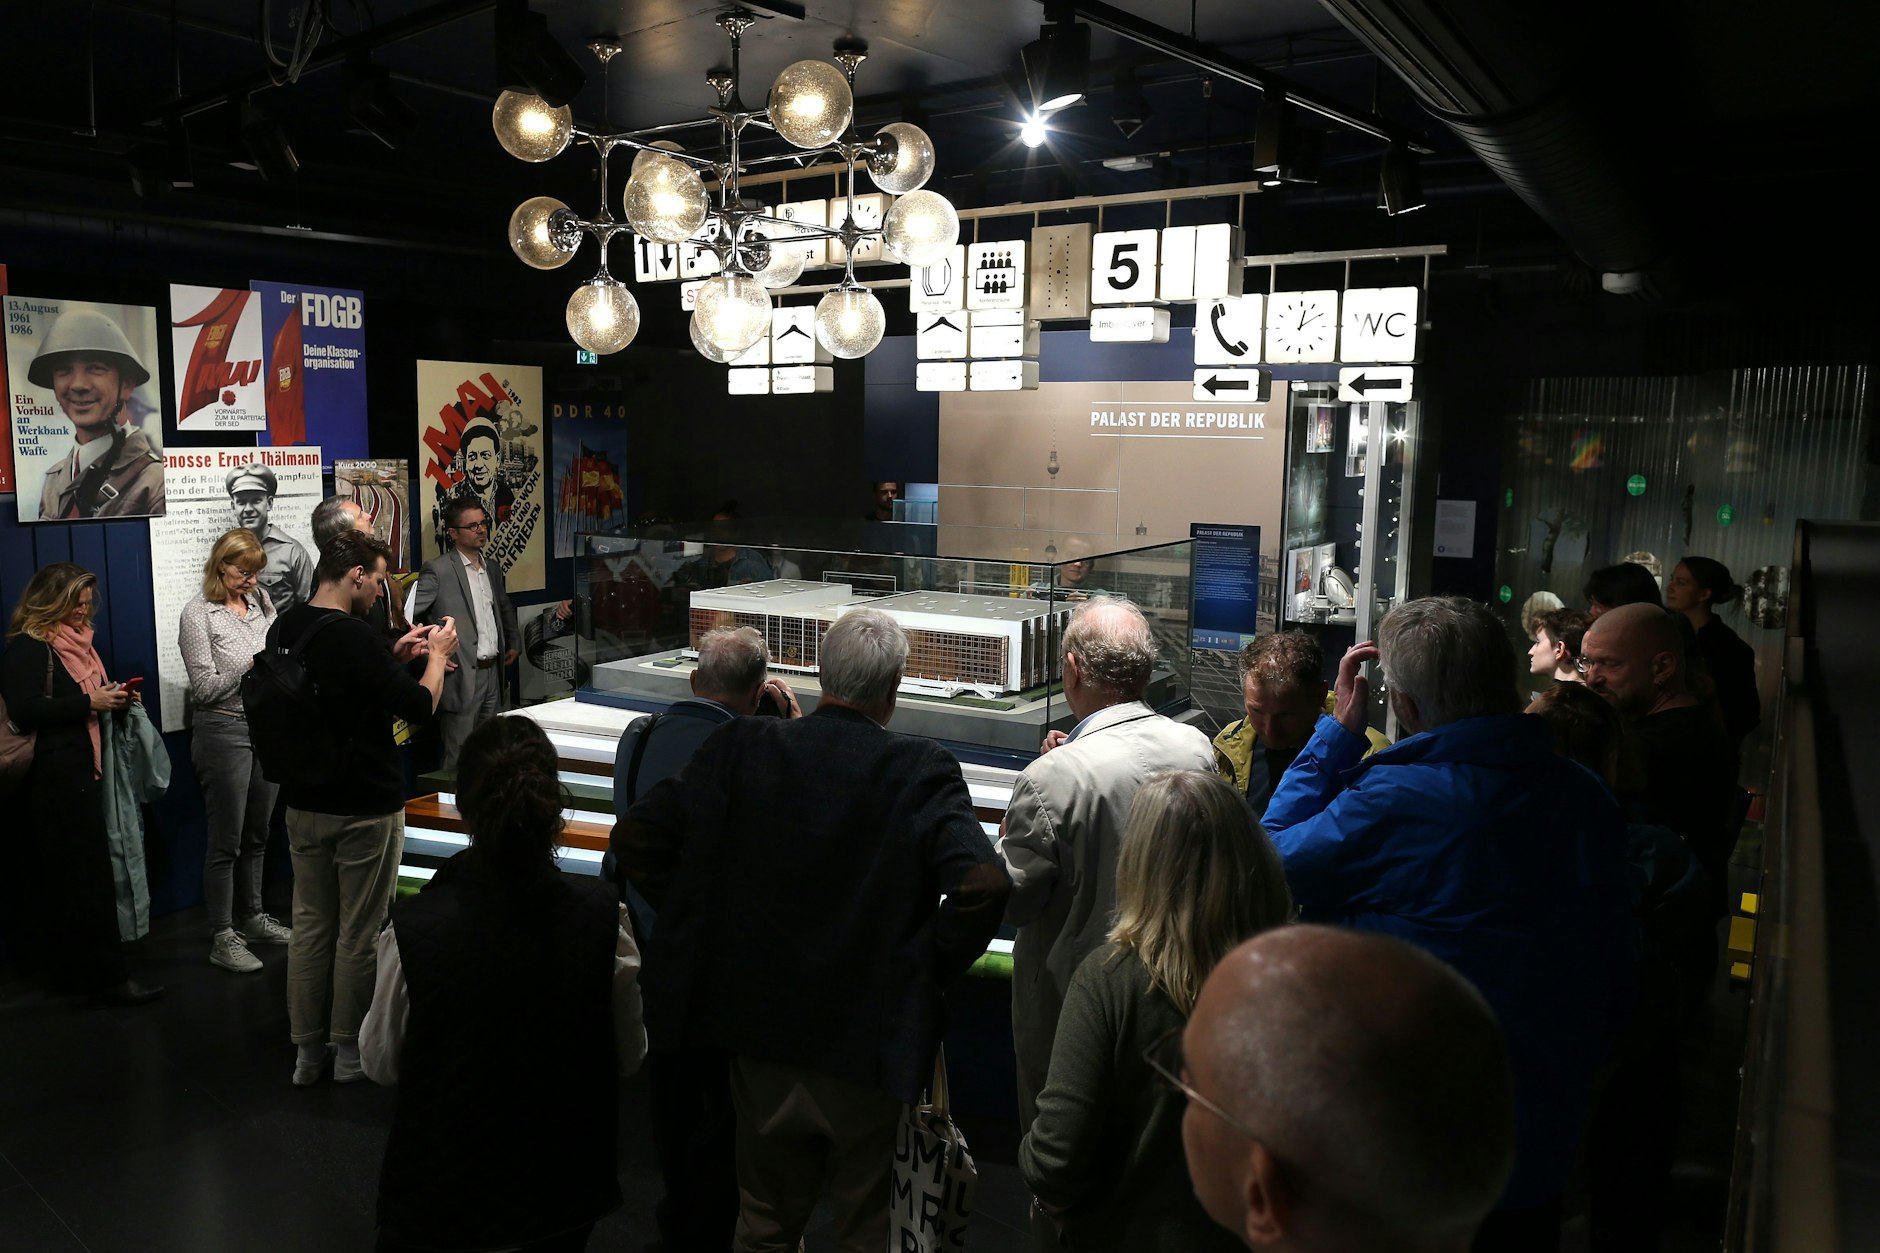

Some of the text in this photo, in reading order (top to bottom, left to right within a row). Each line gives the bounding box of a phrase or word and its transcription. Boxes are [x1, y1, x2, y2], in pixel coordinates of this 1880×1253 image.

[1107, 243, 1139, 290] 5
[8, 301, 59, 314] 13. August
[280, 290, 363, 330] Der FDGB
[9, 313, 31, 323] 1961
[10, 324, 33, 335] 1986
[1354, 312, 1407, 338] WC
[303, 344, 361, 358] Deine Klassen-
[304, 357, 355, 370] organisation
[15, 395, 34, 404] Ein
[507, 388, 522, 407] 1982
[16, 406, 54, 416] Vorbild
[553, 404, 626, 418] DDR 40
[17, 416, 30, 424] an
[1090, 411, 1265, 429] PALAST DER REPUBLIK
[17, 426, 69, 435] Werkbank
[422, 372, 514, 490] 1. MAI
[18, 436, 39, 445] und
[19, 446, 48, 456] Waffe
[162, 450, 319, 468] enosse Ernst Thälmann
[355, 461, 377, 469] 2000
[181, 475, 197, 484] die
[188, 486, 205, 495] der
[485, 533, 503, 560] ALLES
[510, 499, 522, 518] DAS
[520, 470, 541, 502] WOHL
[516, 501, 531, 523] UND
[507, 503, 542, 542] FRIEDEN
